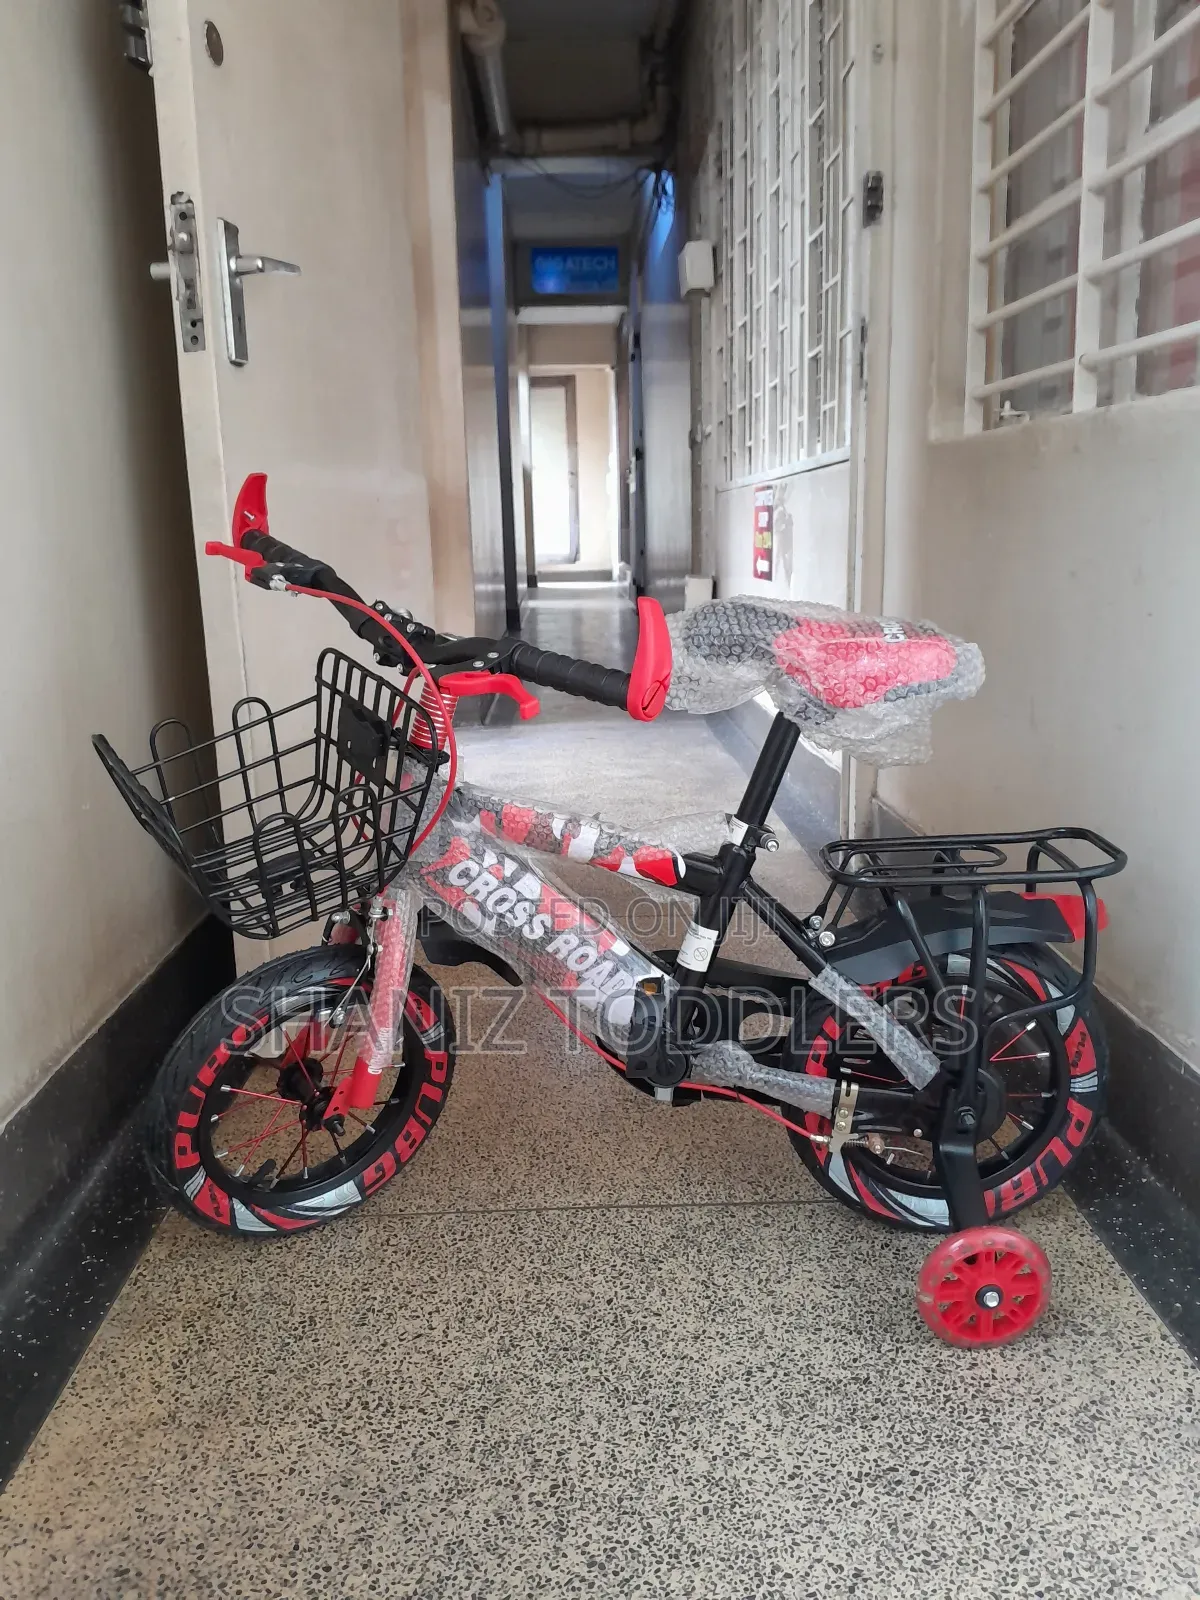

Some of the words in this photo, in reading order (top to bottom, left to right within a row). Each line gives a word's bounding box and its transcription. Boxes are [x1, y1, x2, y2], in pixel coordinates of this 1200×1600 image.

[449, 860, 552, 940] CROSS
[545, 929, 635, 998] ROAD
[363, 1048, 449, 1196] PUBG
